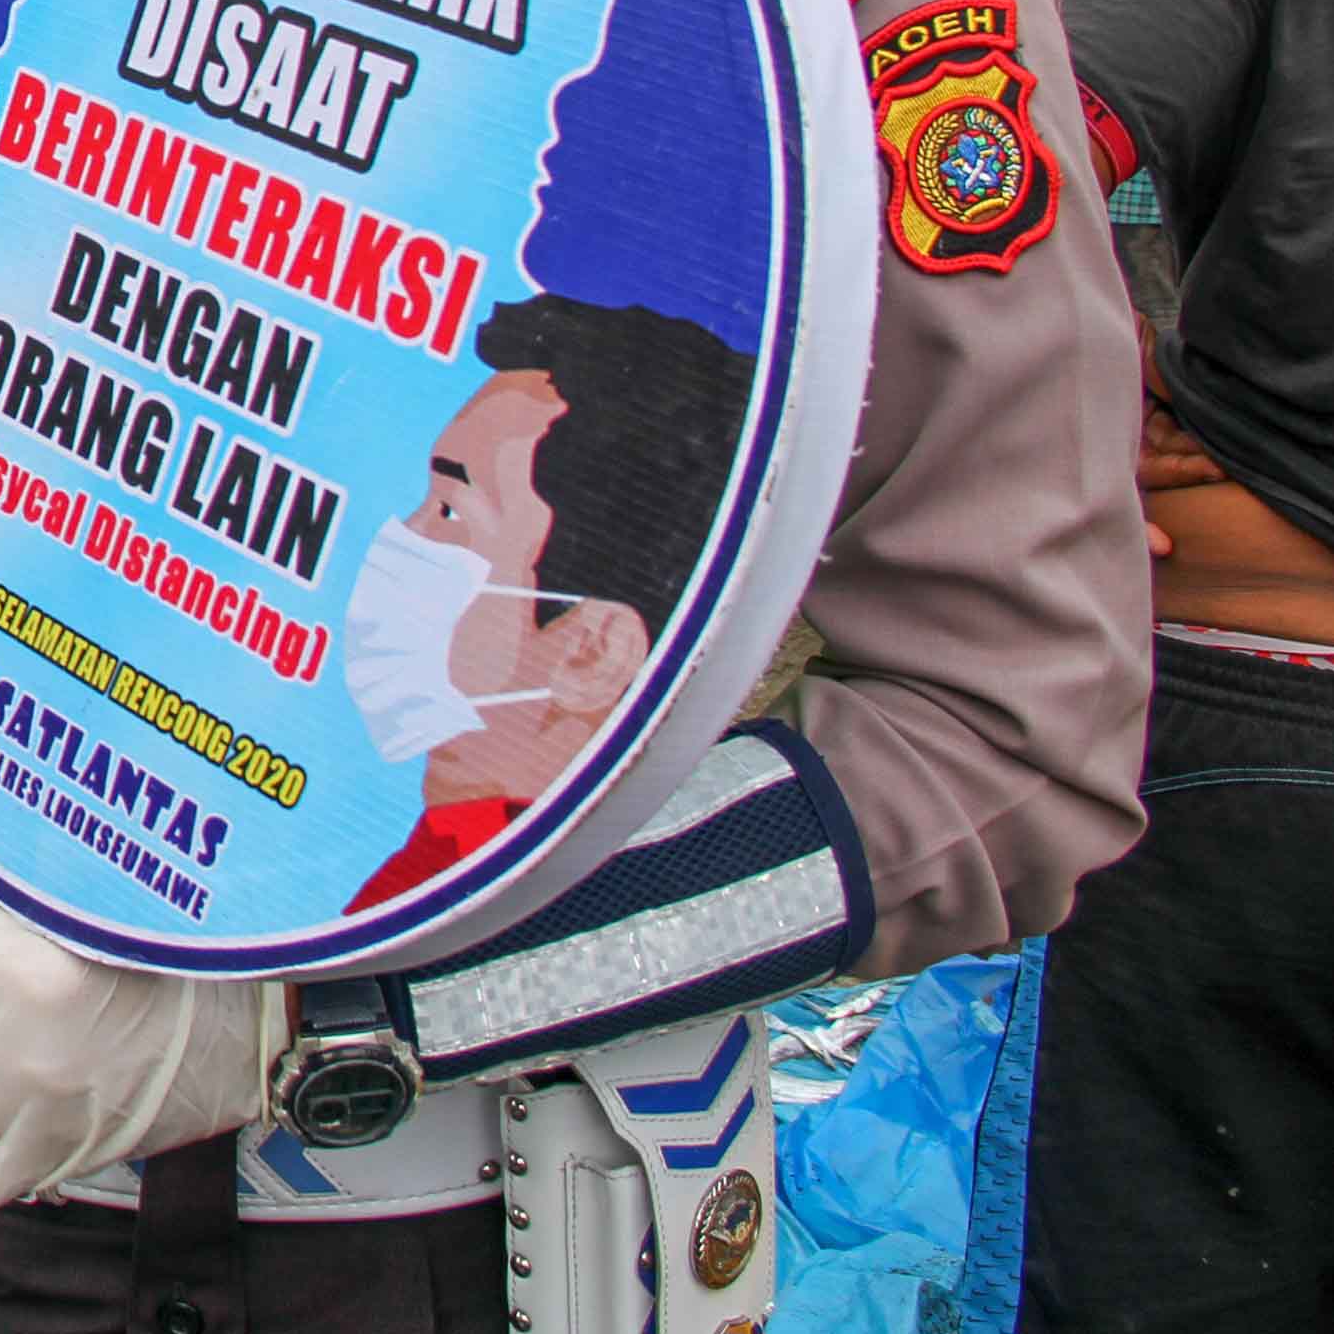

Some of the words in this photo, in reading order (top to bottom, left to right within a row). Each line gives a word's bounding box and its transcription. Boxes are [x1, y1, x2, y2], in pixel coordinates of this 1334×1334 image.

[50, 231, 315, 428] DENGAN
[170, 423, 340, 582] LAIN
[109, 662, 233, 765] RENCONG
[226, 736, 307, 809] 2020
[41, 786, 211, 923] LHOKSEUMAWE
